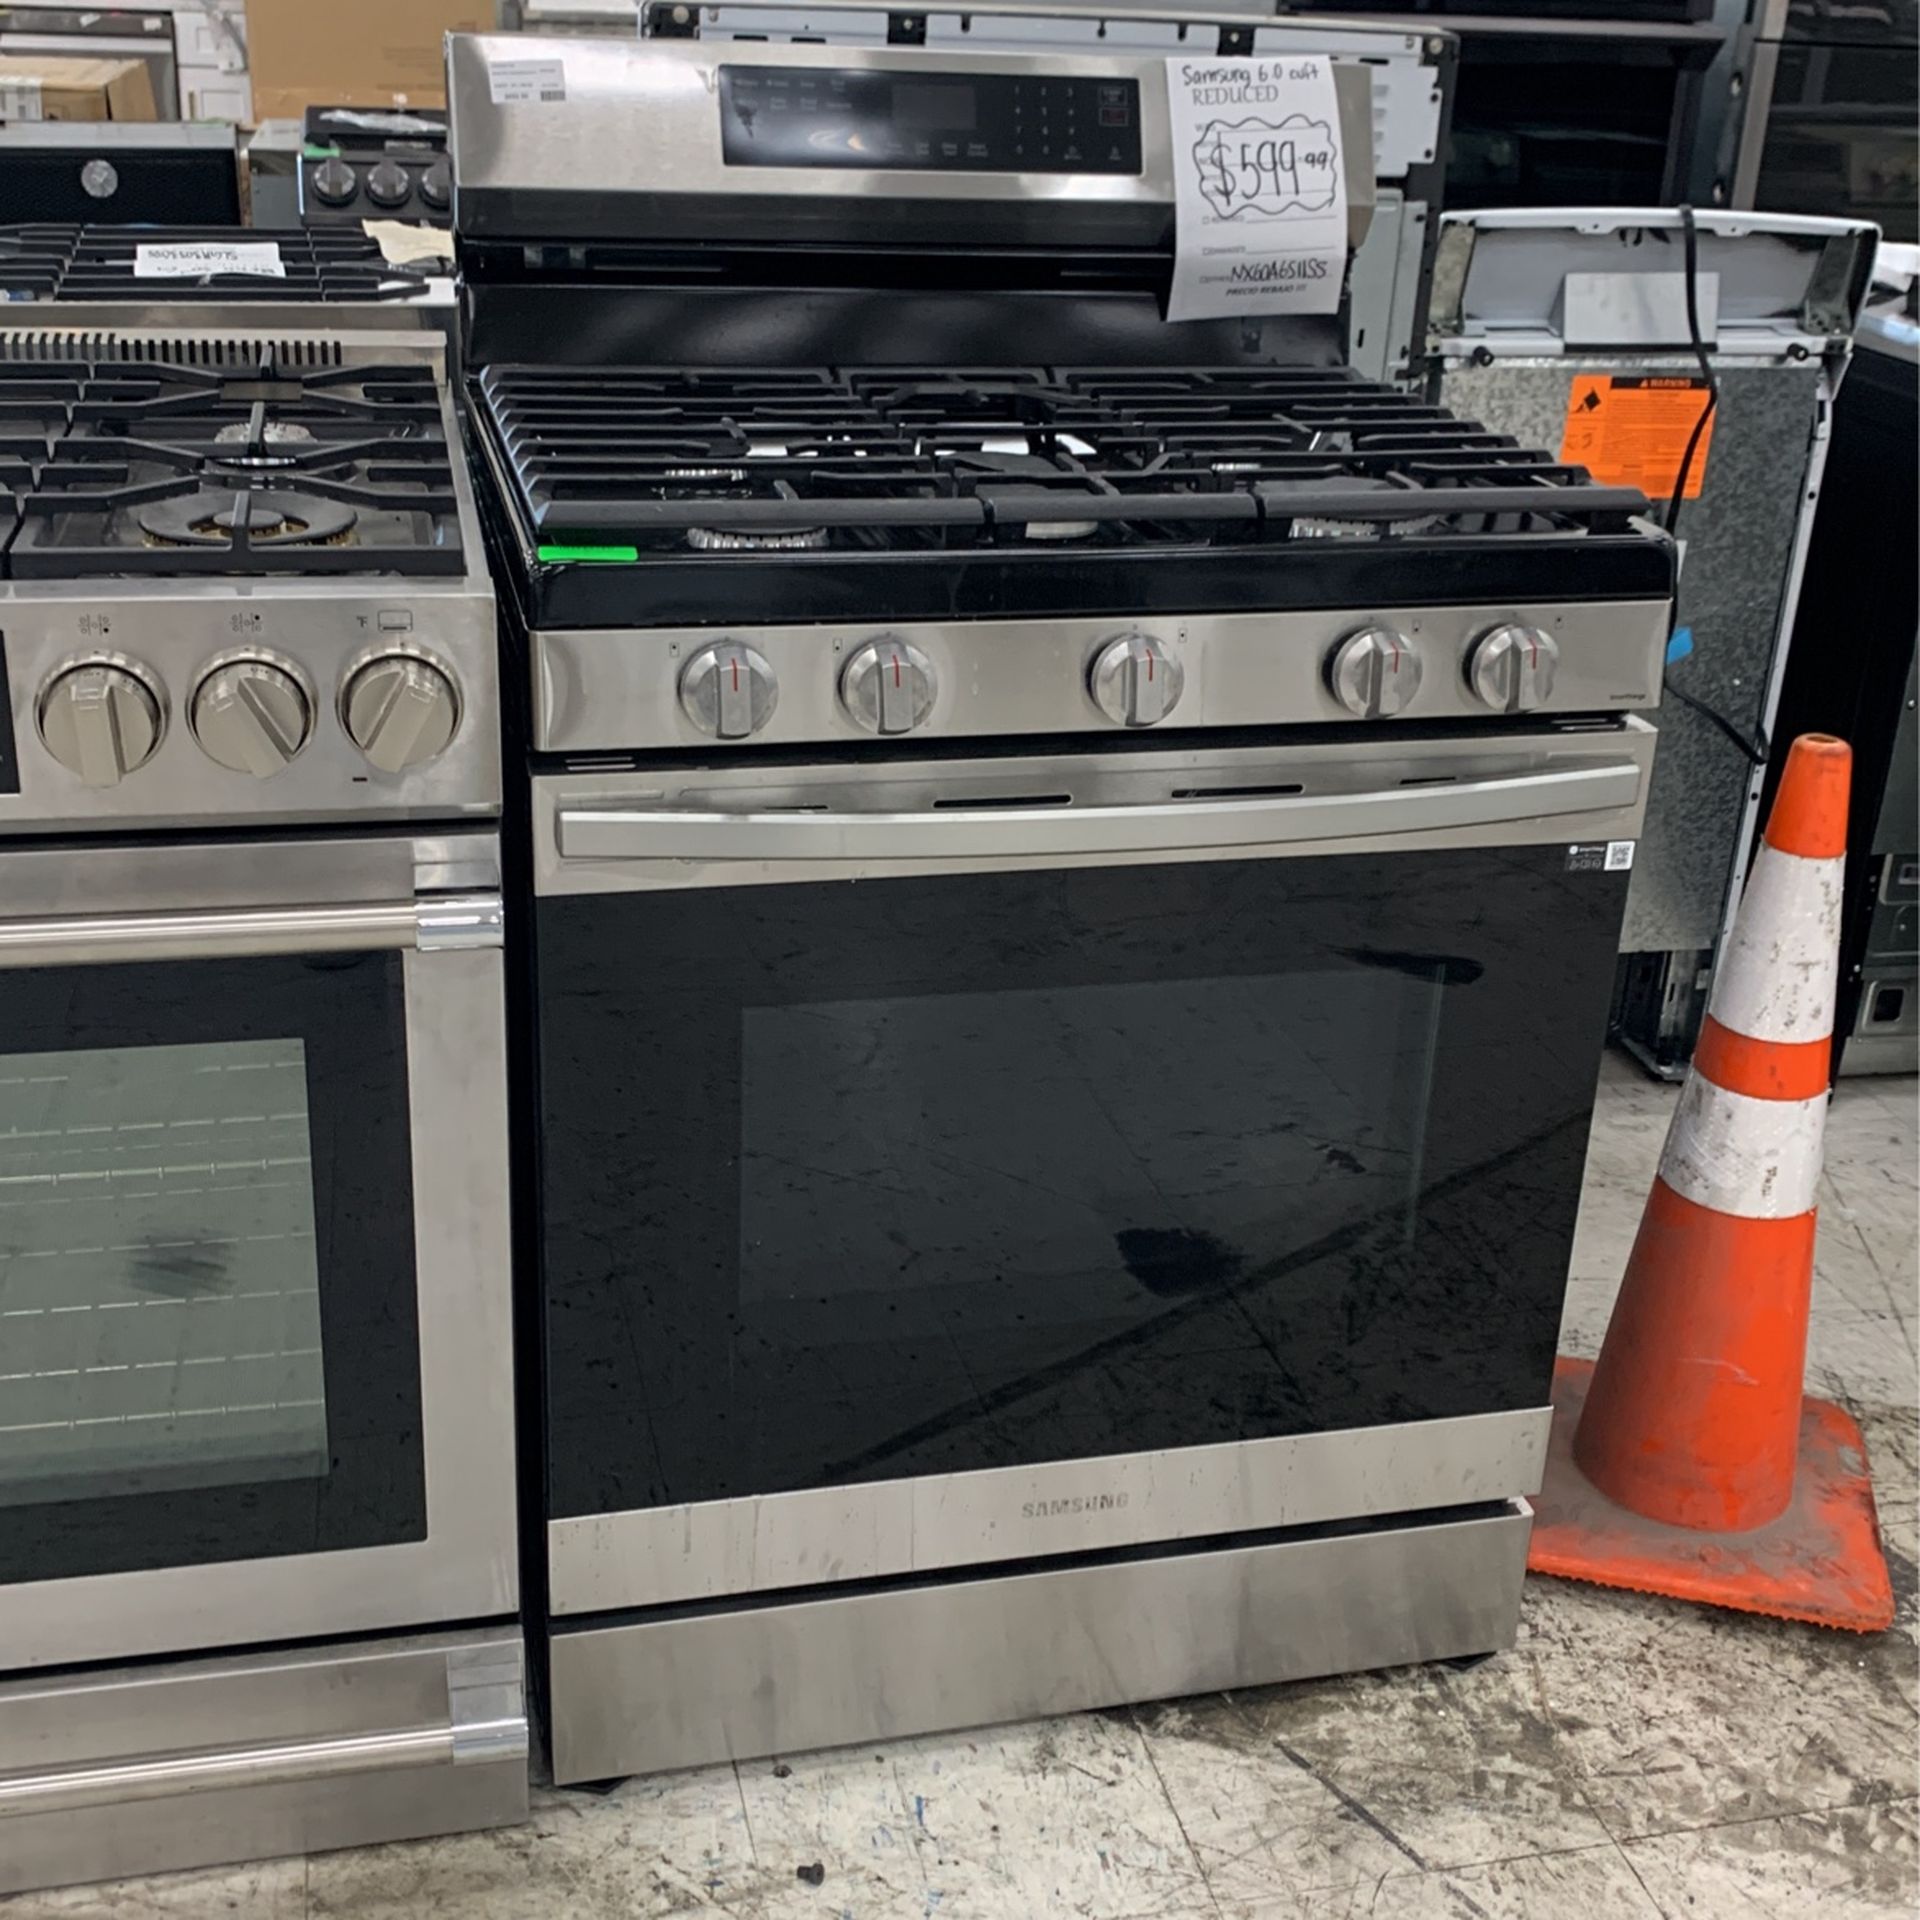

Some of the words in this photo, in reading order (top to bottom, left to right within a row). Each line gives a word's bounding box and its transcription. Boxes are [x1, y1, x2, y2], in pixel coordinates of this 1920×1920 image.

[1182, 65, 1251, 89] Samsung
[1192, 86, 1279, 106] REDUCED
[1022, 1493, 1129, 1518] SAMSUNG
